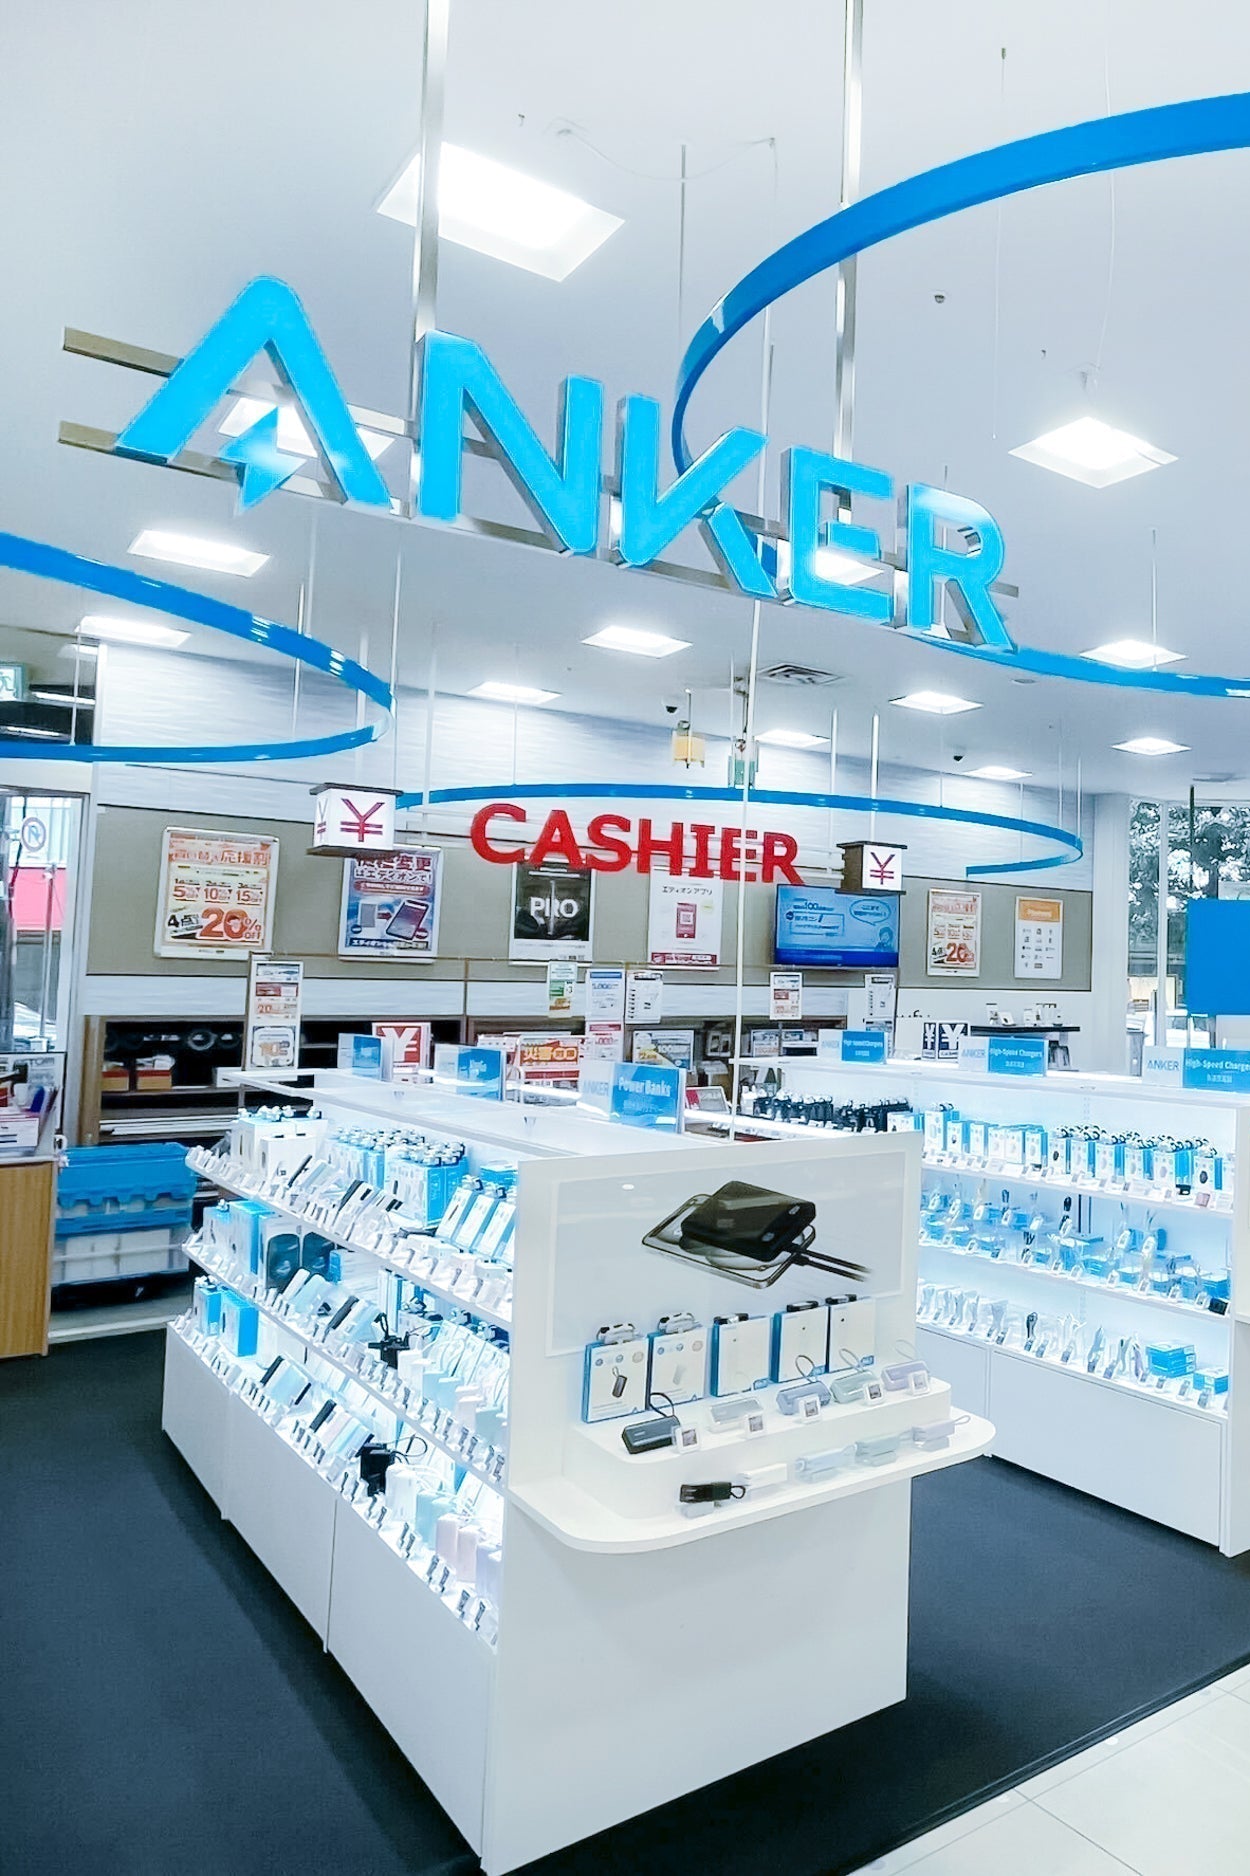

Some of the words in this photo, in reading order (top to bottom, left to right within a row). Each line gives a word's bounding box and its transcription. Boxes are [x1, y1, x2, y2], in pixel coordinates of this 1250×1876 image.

[115, 275, 1018, 653] ANKER
[340, 798, 385, 842] ¥
[470, 803, 804, 885] CASHIER
[1146, 1059, 1180, 1071] ANKER
